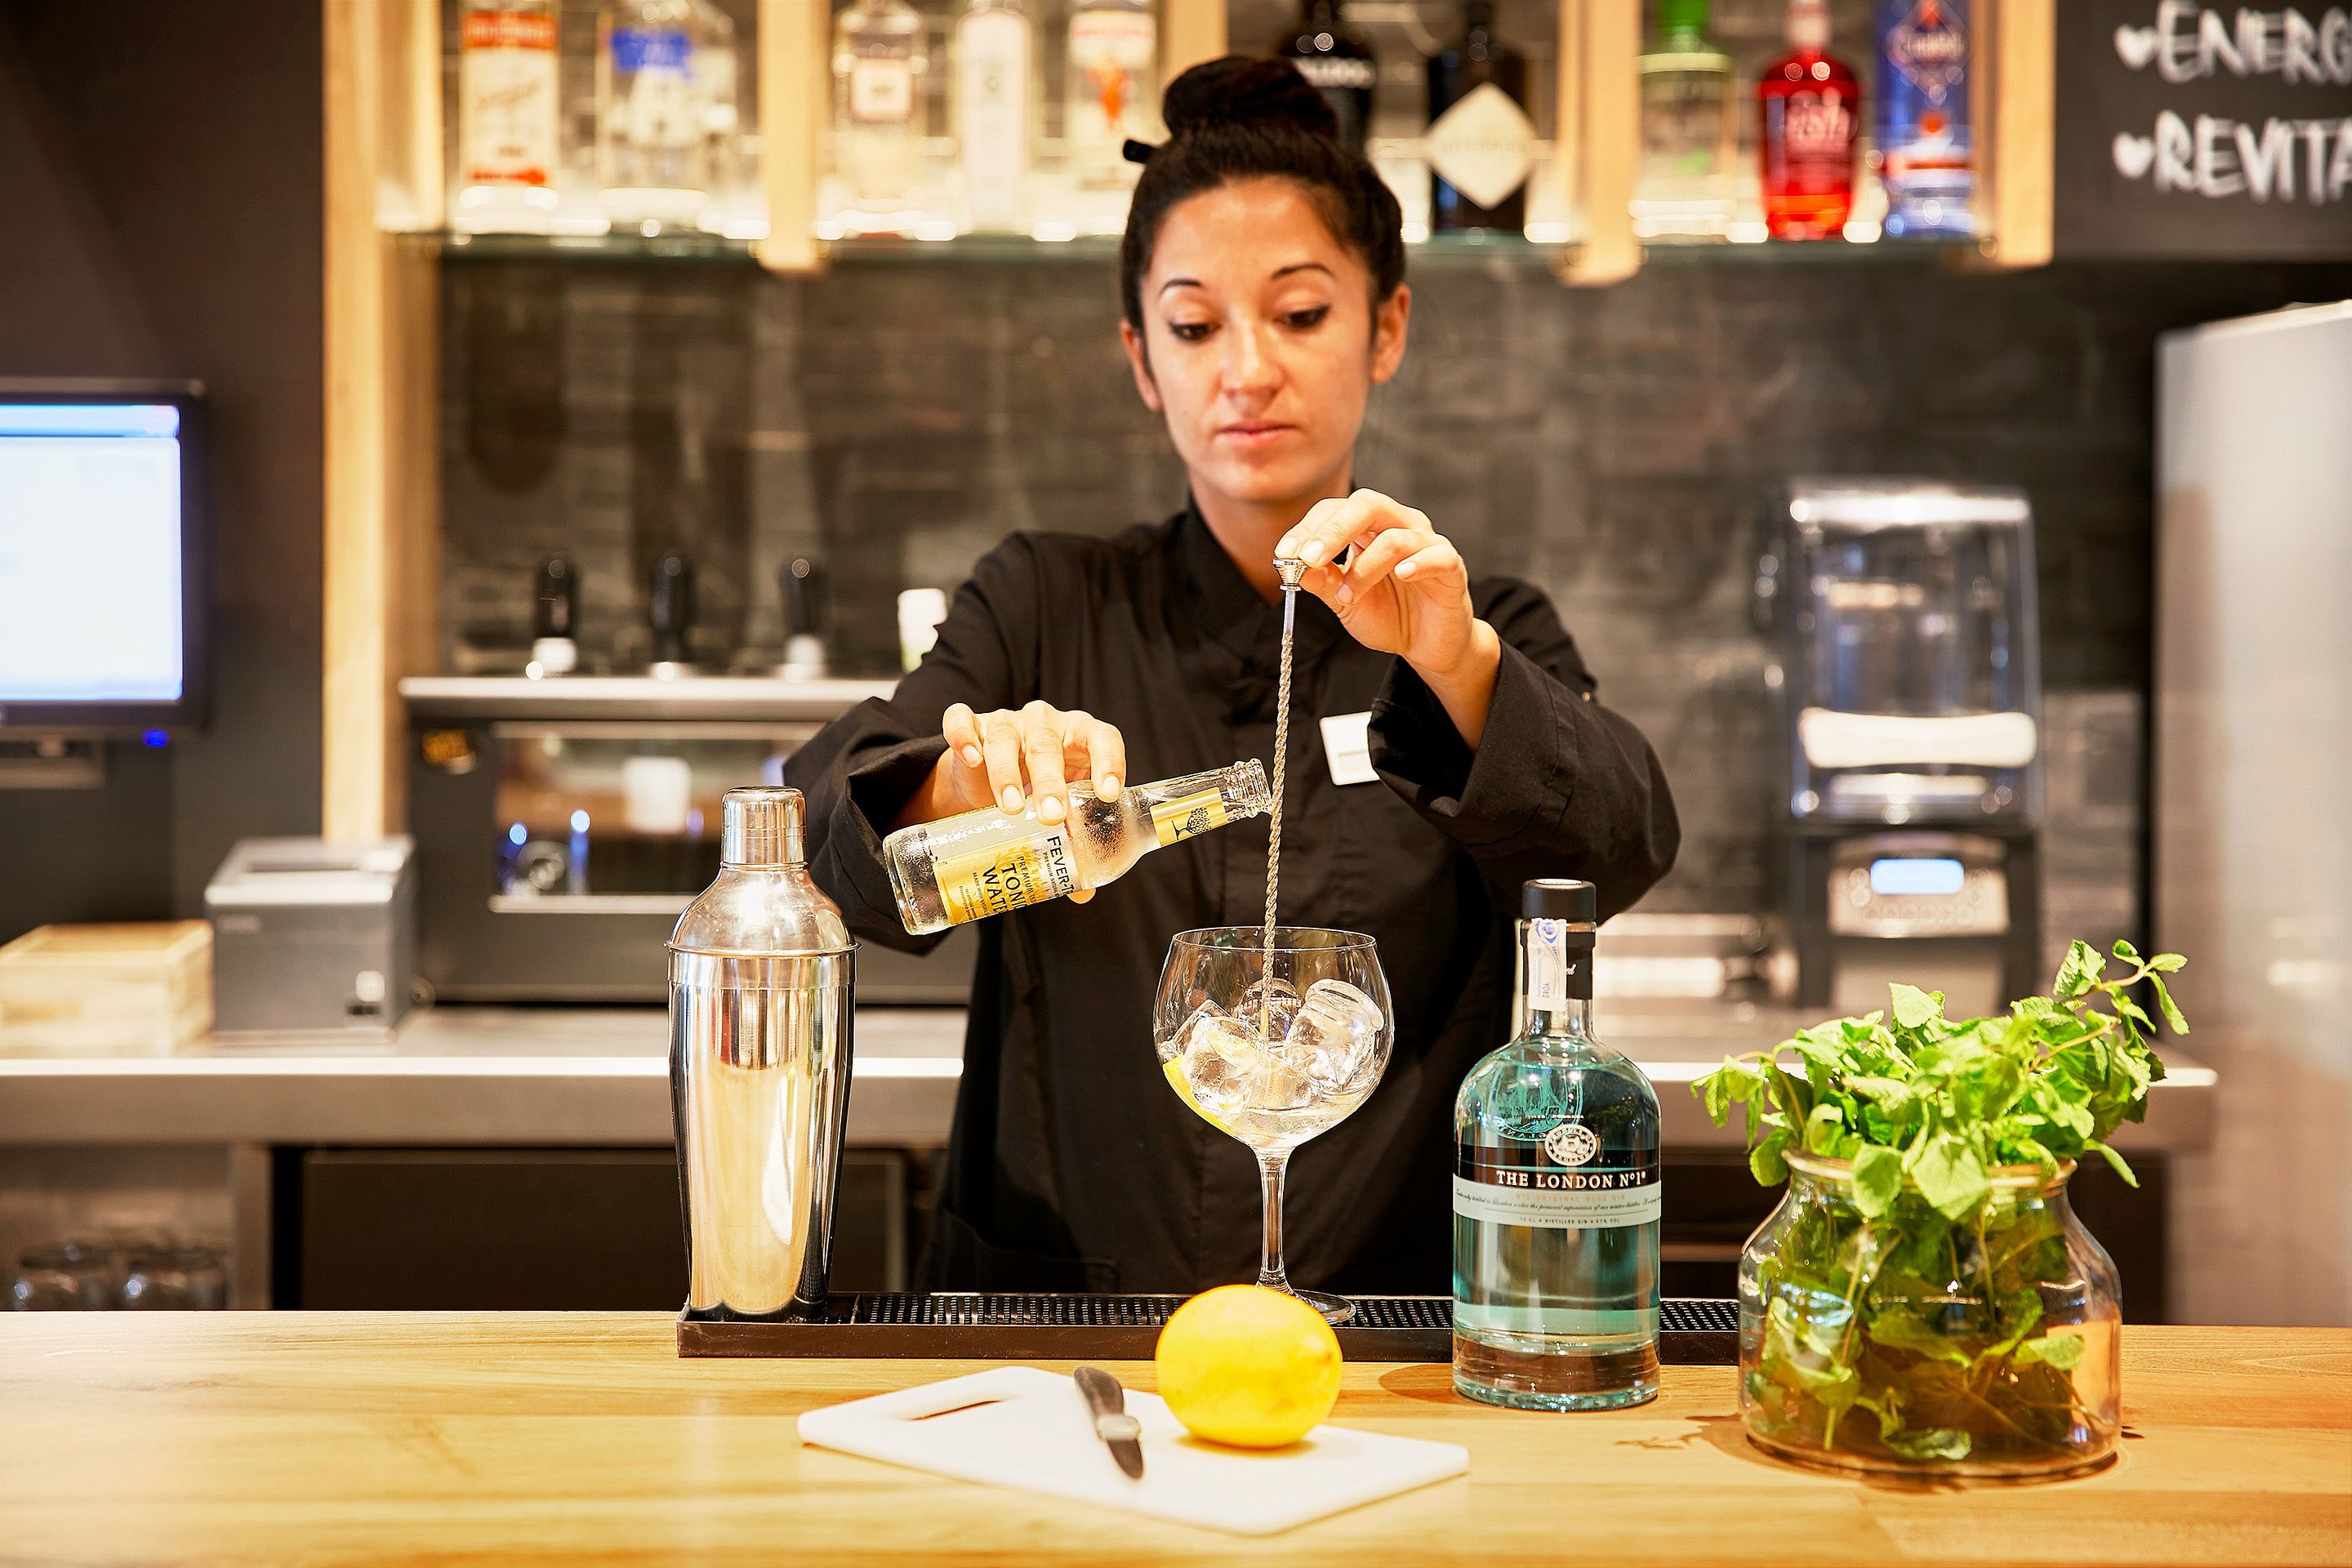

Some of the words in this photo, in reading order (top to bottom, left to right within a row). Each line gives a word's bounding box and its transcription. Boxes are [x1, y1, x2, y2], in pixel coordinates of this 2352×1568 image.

[1018, 856, 1034, 893] PREMIUM
[1496, 1169, 1529, 1187] THE
[1535, 1174, 1613, 1189] LONDON
